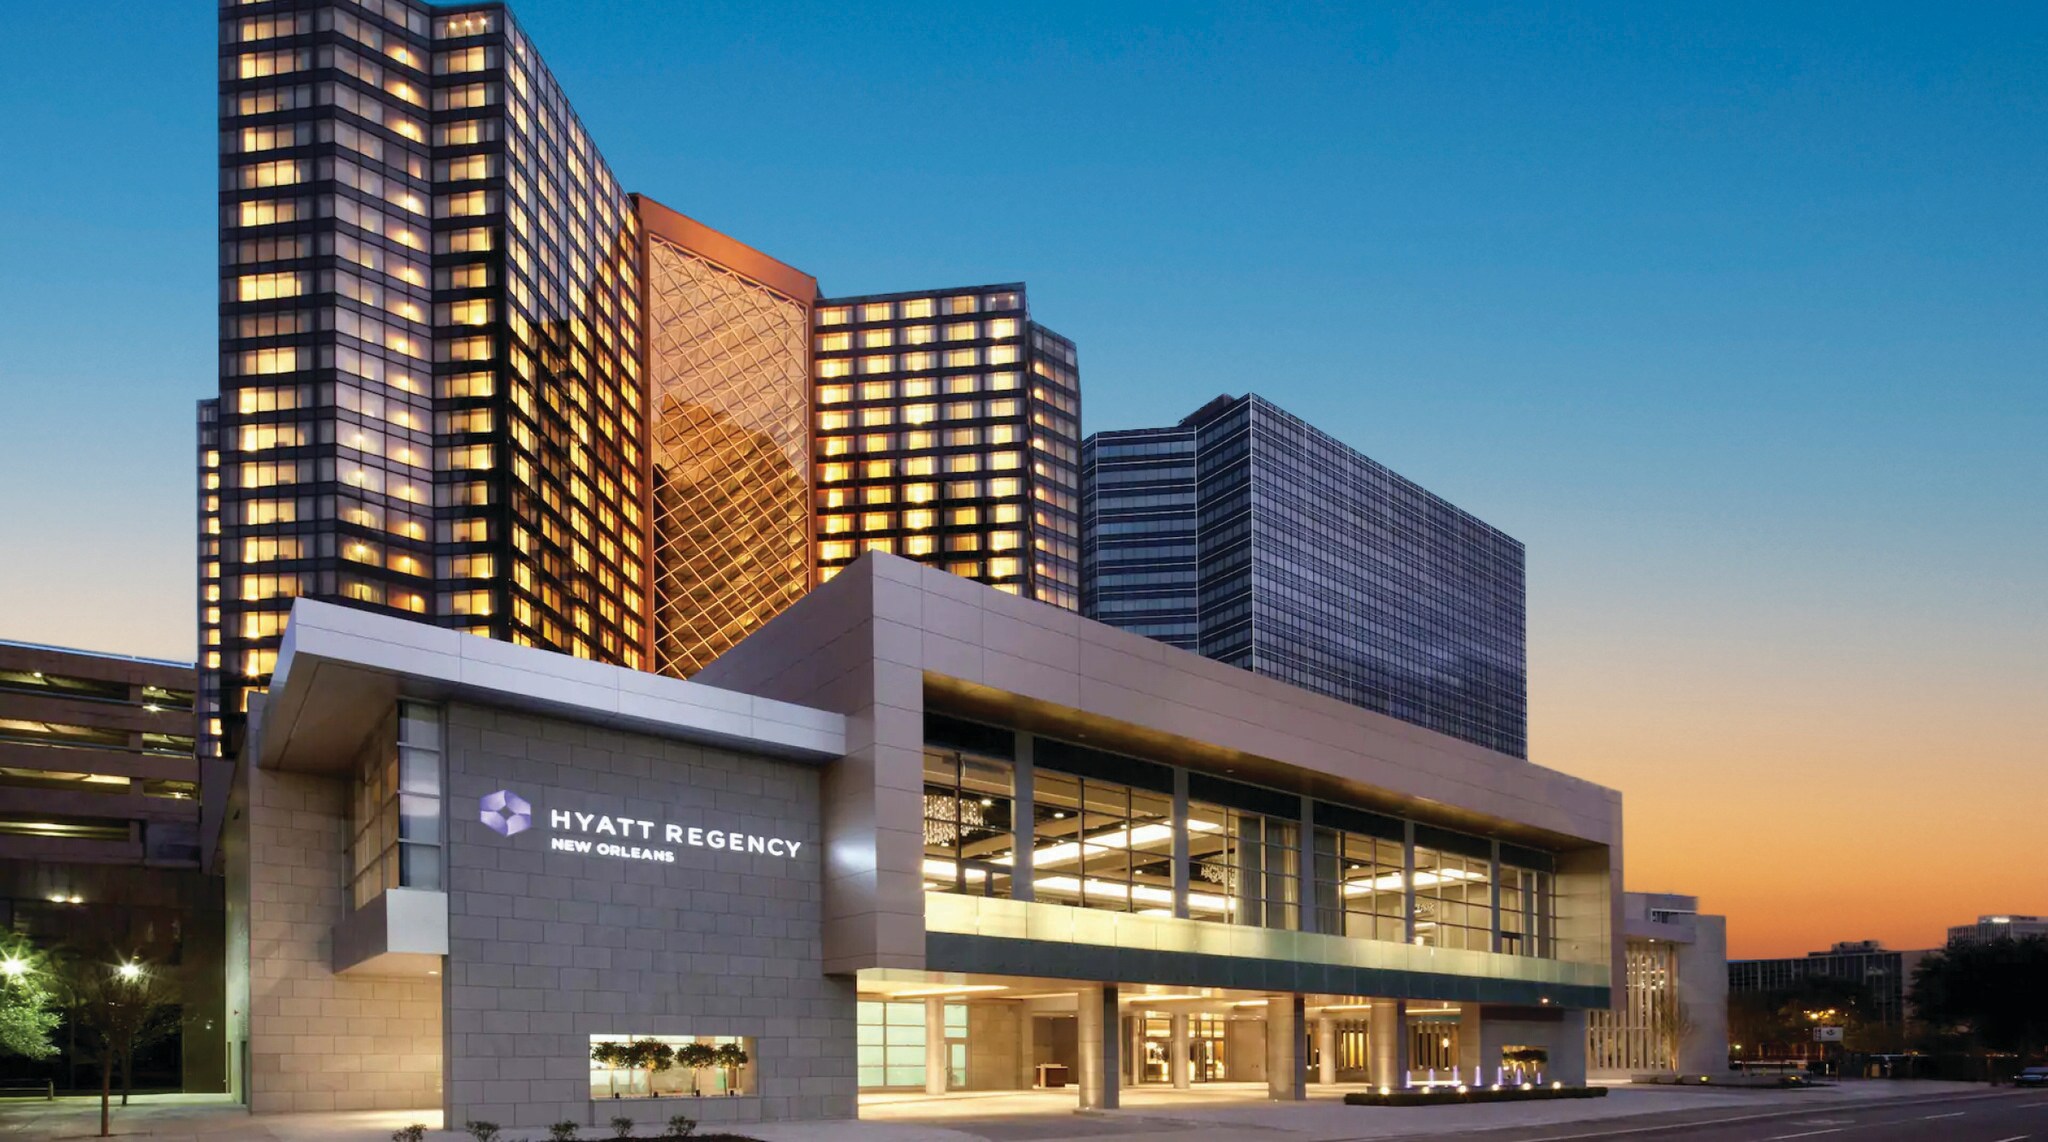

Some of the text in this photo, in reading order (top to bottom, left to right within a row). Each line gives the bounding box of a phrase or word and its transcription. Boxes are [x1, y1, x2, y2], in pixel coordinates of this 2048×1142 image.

[551, 809, 802, 859] HYATT REGENCY
[551, 838, 675, 863] NEW ORLEANS
